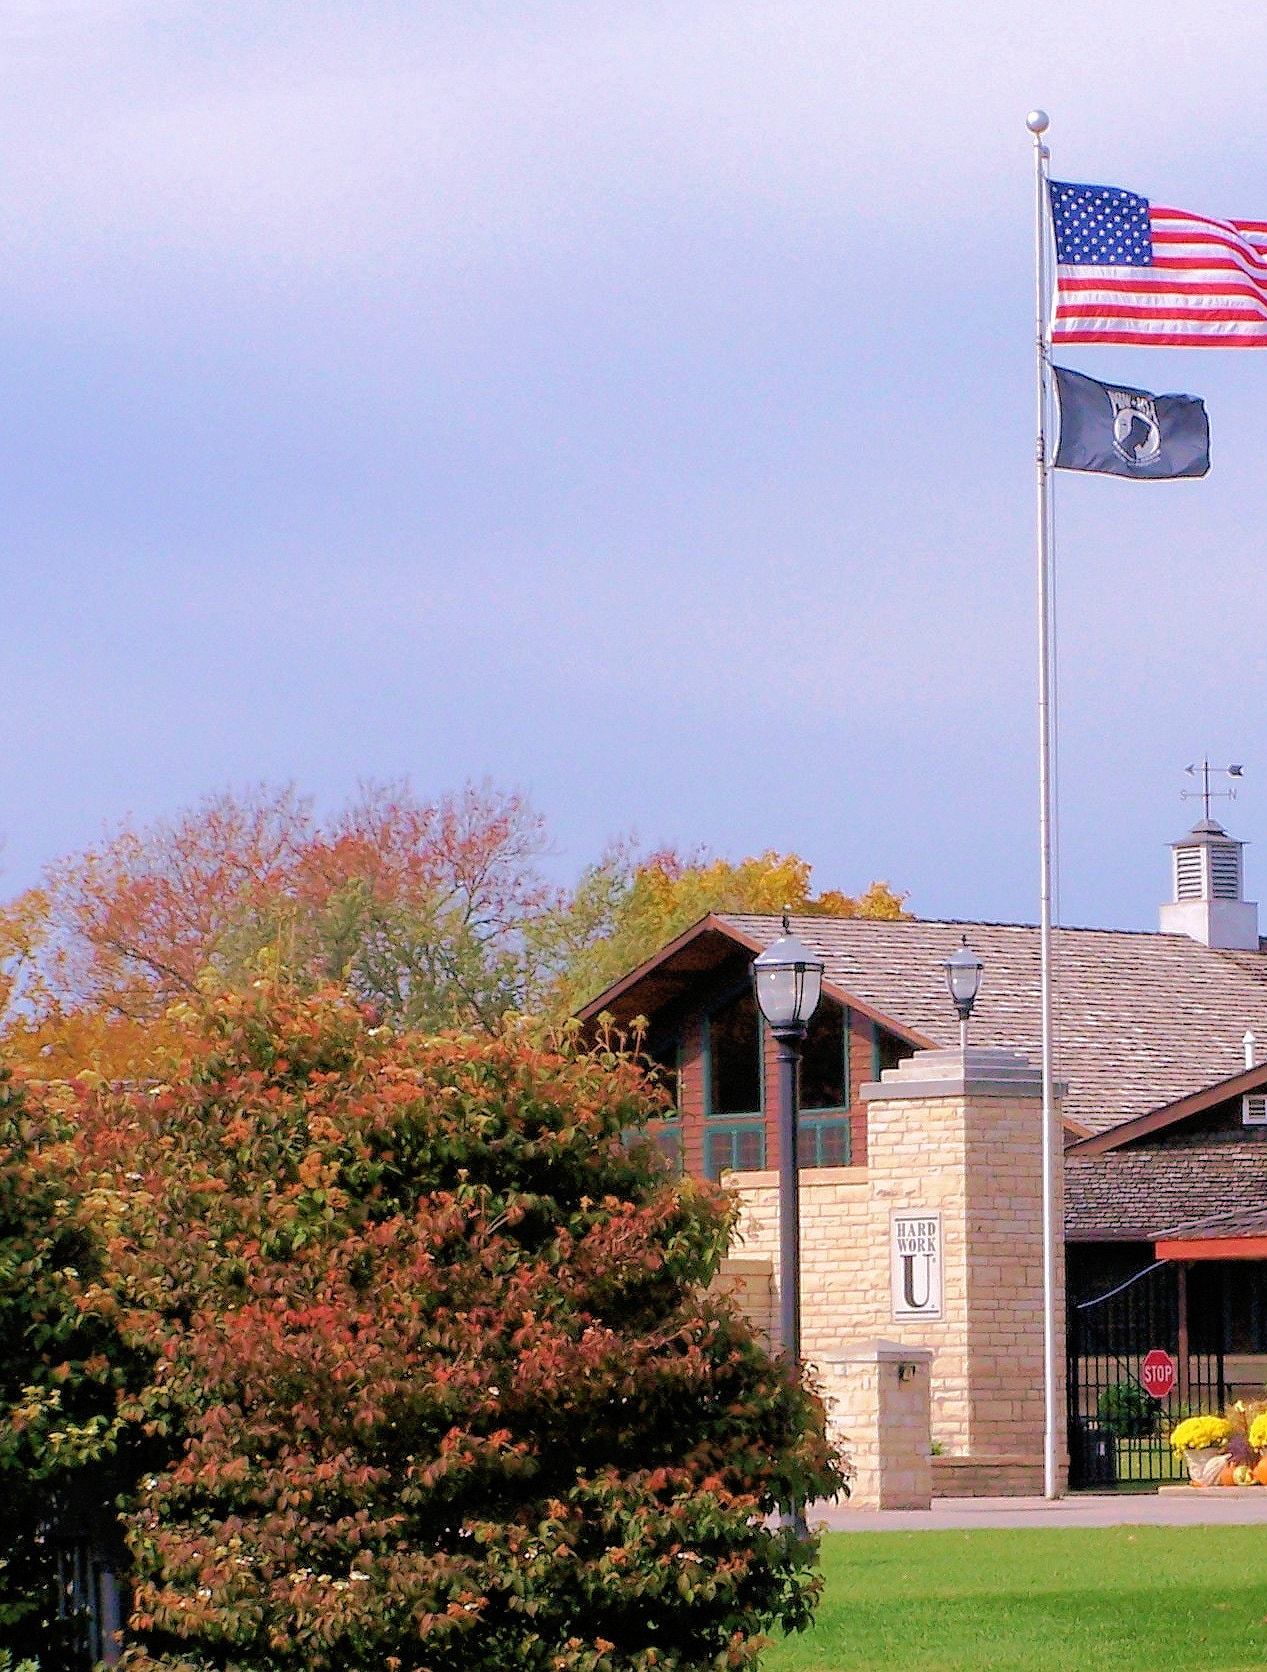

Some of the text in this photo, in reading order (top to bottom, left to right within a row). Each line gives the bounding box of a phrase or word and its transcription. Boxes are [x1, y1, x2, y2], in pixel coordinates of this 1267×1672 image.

[897, 1222, 936, 1237] HARD
[897, 1238, 936, 1252] WORK
[1145, 1365, 1171, 1383] STOP
